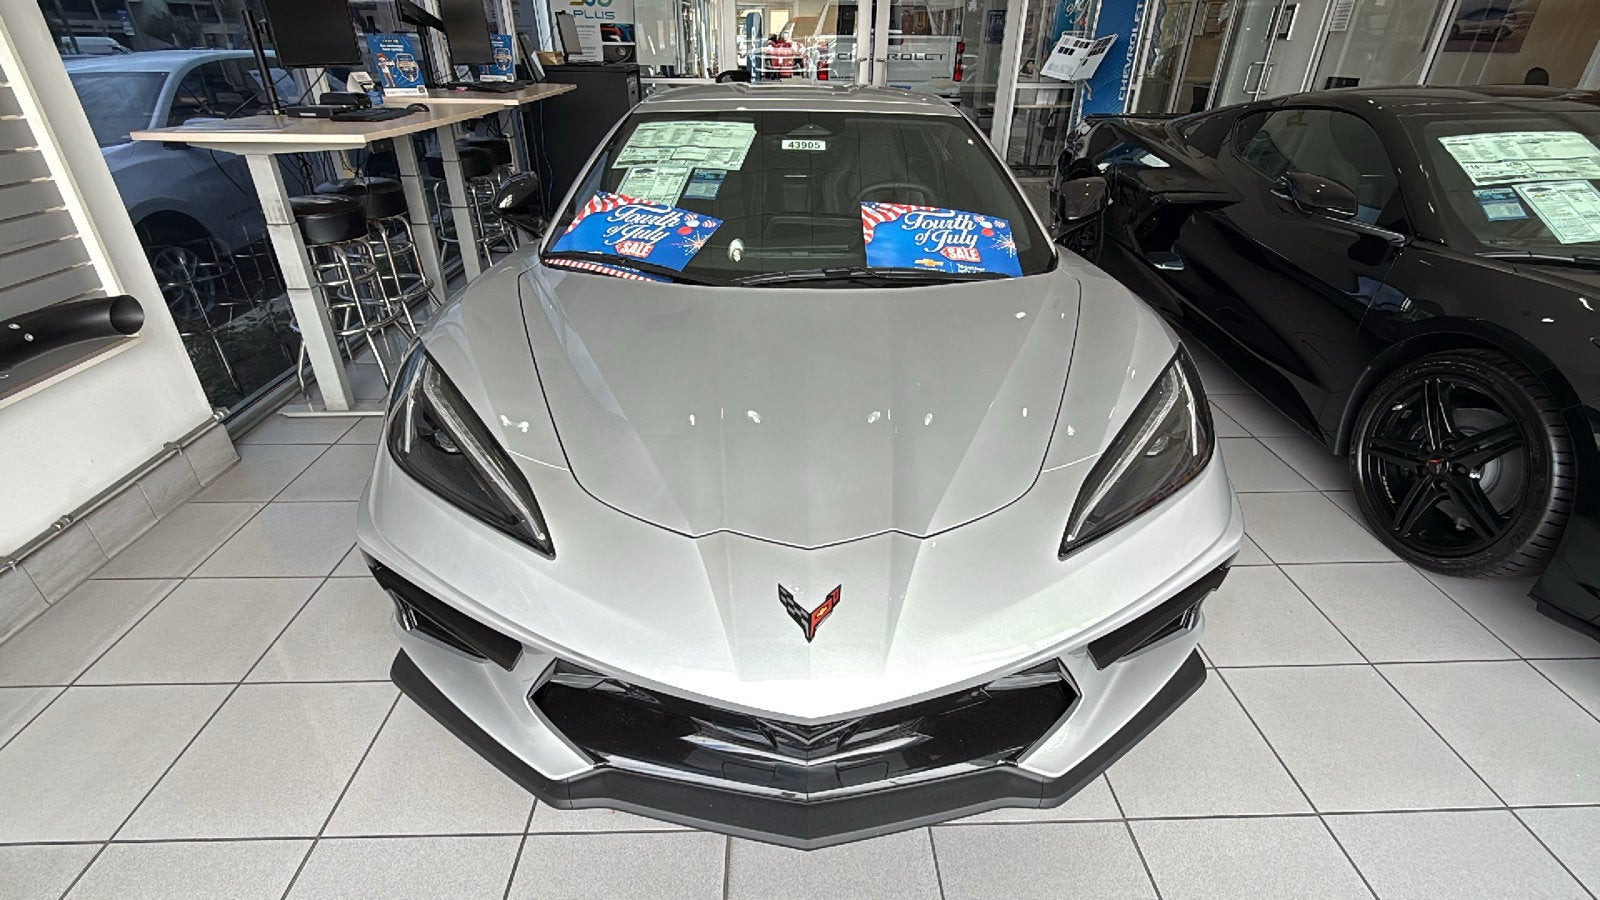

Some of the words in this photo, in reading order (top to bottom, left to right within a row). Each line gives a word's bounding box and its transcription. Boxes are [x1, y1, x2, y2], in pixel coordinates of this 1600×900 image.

[572, 9, 616, 19] PLUS
[837, 52, 948, 61] CROLET
[1118, 0, 1143, 101] CHEVROLET
[787, 141, 821, 149] 43905
[606, 204, 684, 228] Fourth
[901, 209, 977, 231] Fourth
[602, 222, 634, 238] of
[603, 224, 671, 246] July
[914, 228, 935, 246] of
[620, 241, 654, 257] SALE
[923, 229, 979, 253] July
[946, 245, 979, 261] SALE
